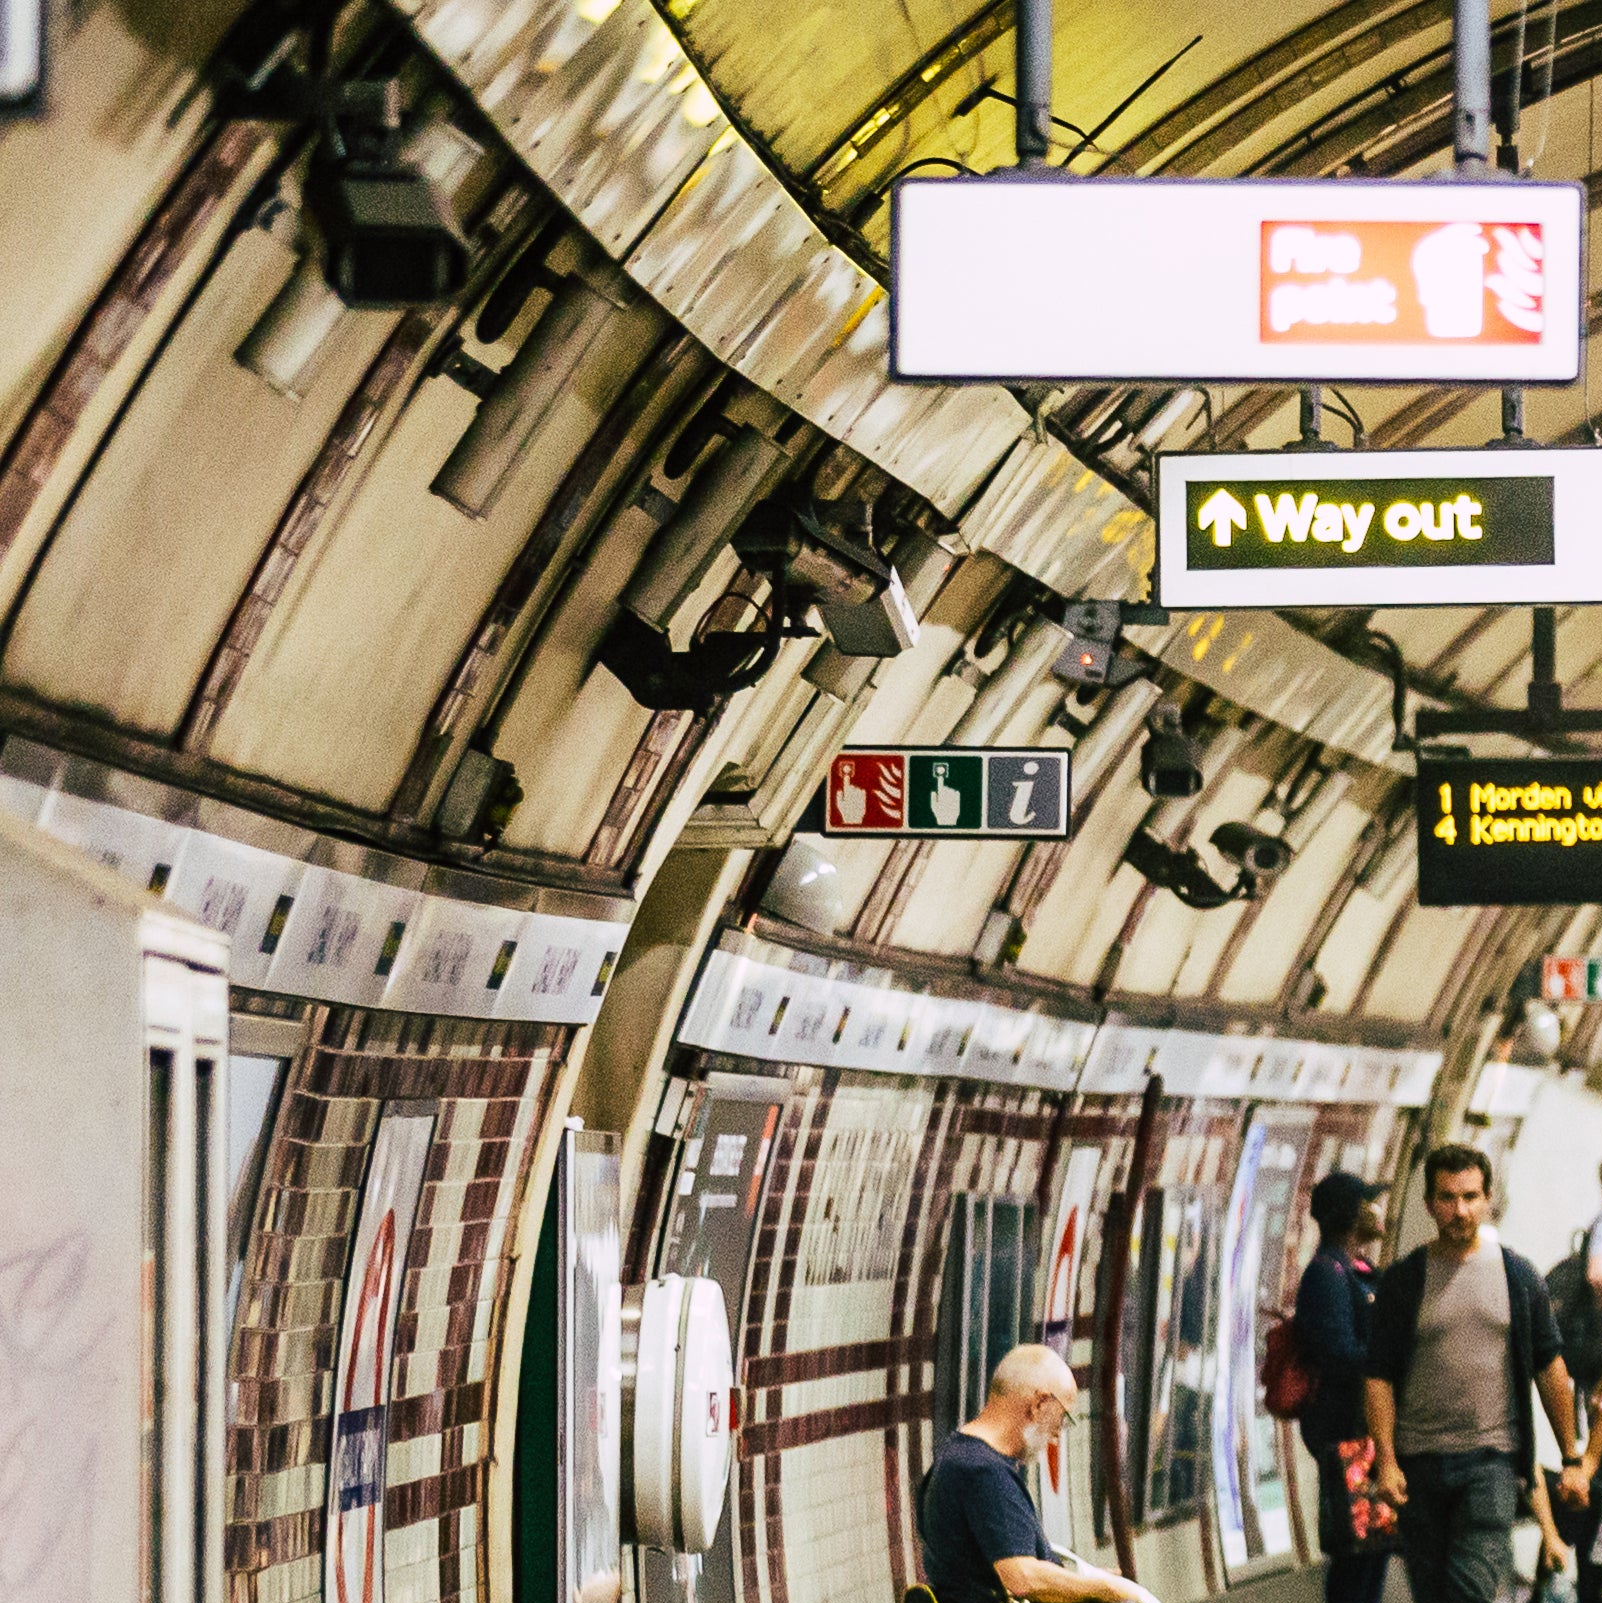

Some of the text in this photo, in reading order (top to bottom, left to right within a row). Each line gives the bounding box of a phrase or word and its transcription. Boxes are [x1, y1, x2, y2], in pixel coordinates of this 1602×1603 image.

[1269, 226, 1361, 274] Fire
[1269, 278, 1398, 332] point
[1254, 492, 1482, 553] Way out
[1439, 784, 1453, 813] 1
[1470, 783, 1573, 813] Morden
[1434, 813, 1457, 844] 4
